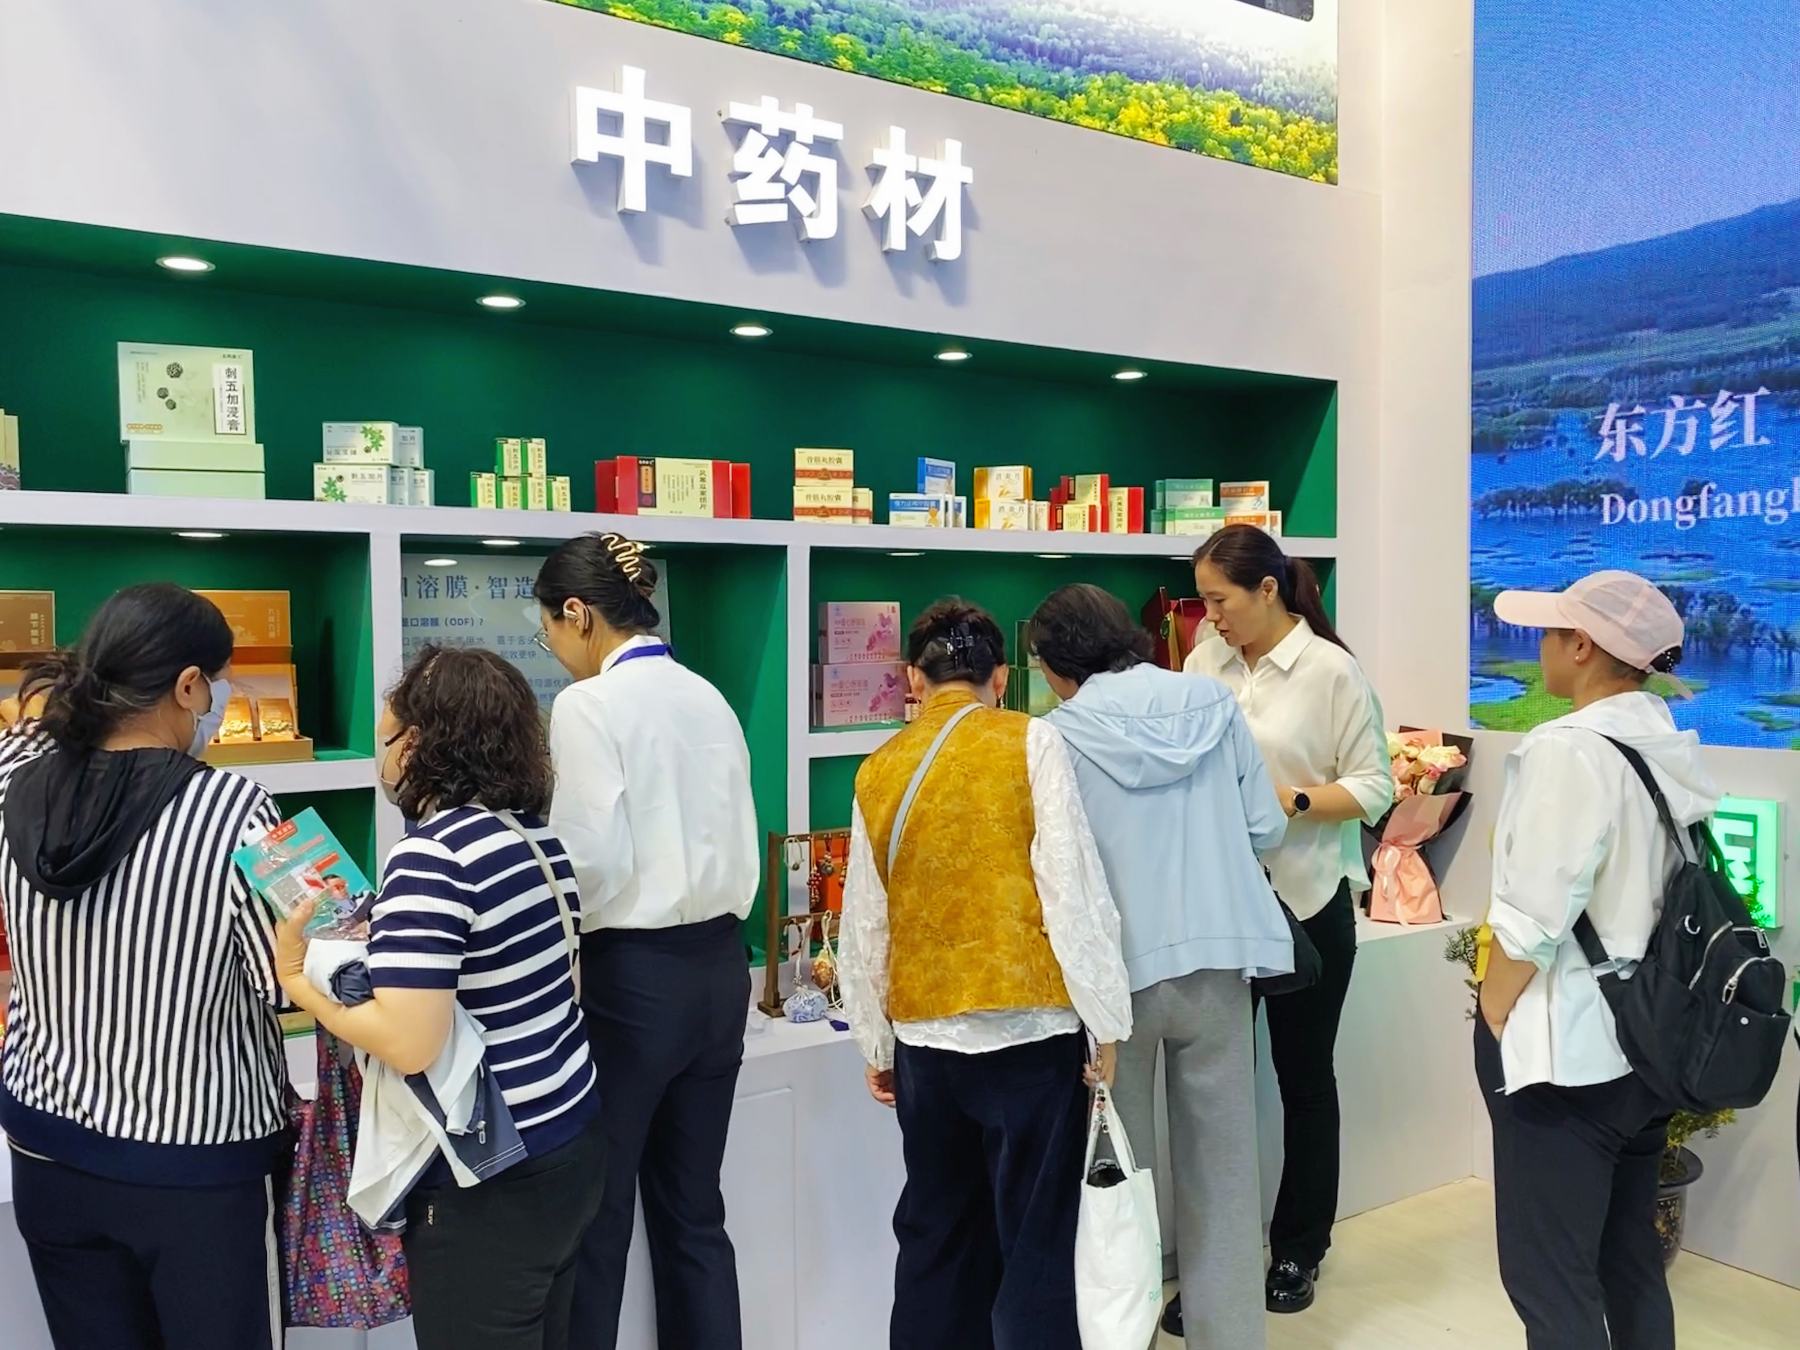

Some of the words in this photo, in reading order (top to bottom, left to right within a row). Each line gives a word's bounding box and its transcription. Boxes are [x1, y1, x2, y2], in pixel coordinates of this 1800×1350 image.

[571, 64, 974, 262] 中药材
[1594, 386, 1772, 462] 东方红
